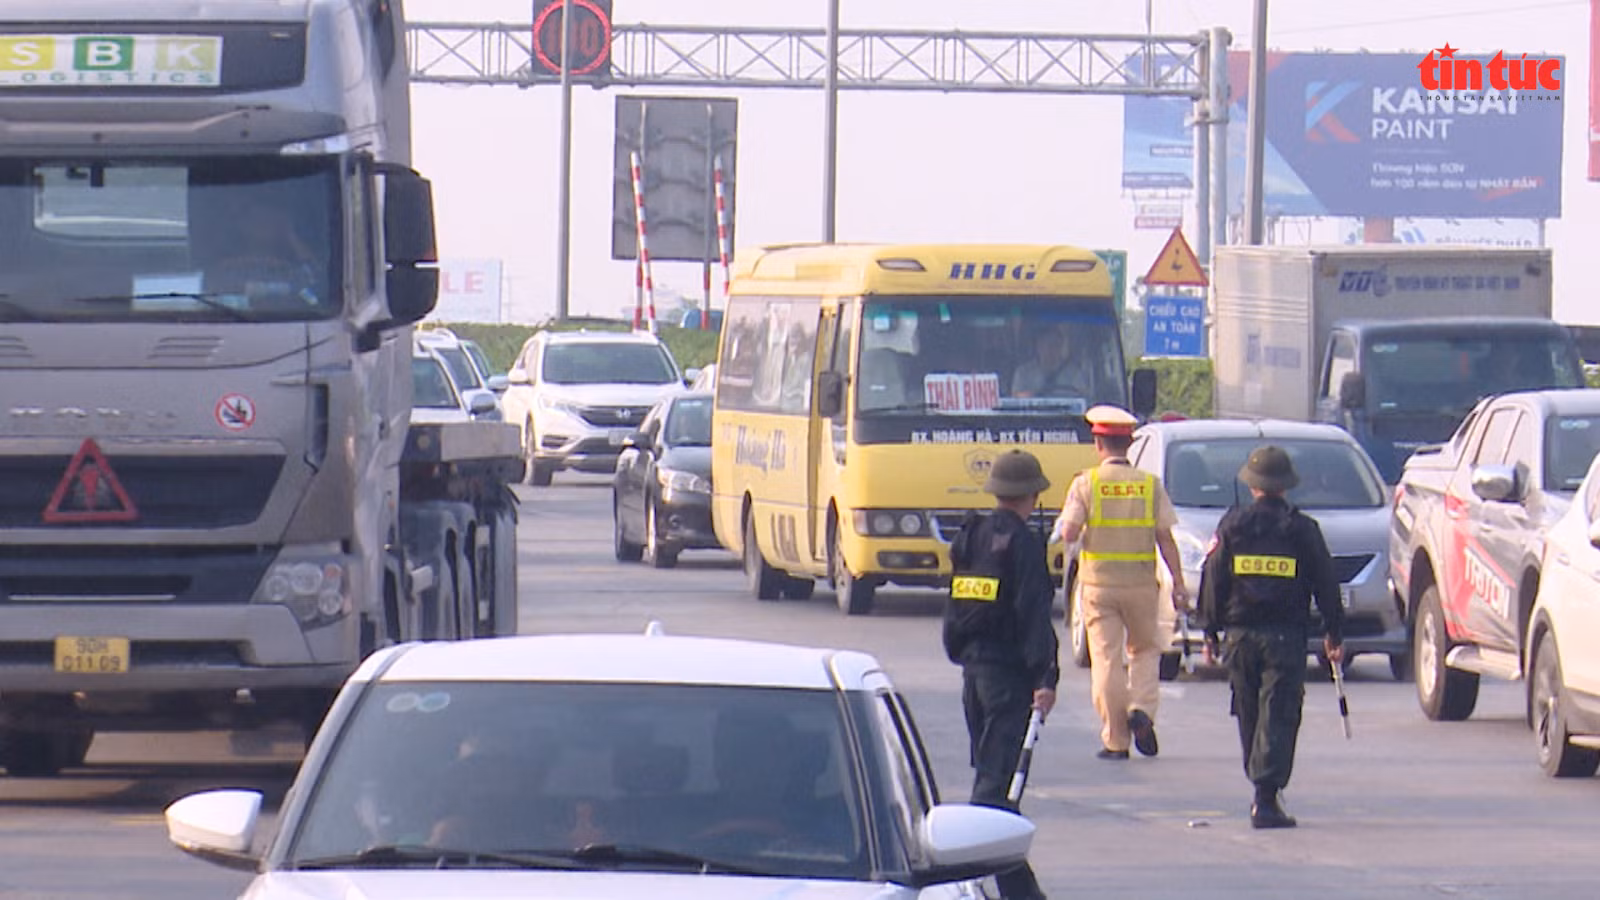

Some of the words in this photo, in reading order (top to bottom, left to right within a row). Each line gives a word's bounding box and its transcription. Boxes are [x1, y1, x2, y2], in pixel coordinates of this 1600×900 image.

[1372, 87, 1518, 115] KANSAI
[1371, 118, 1454, 140] PAINT
[926, 377, 960, 410] THÁI
[963, 374, 998, 410] BÌNH
[1463, 545, 1511, 620] TRITON
